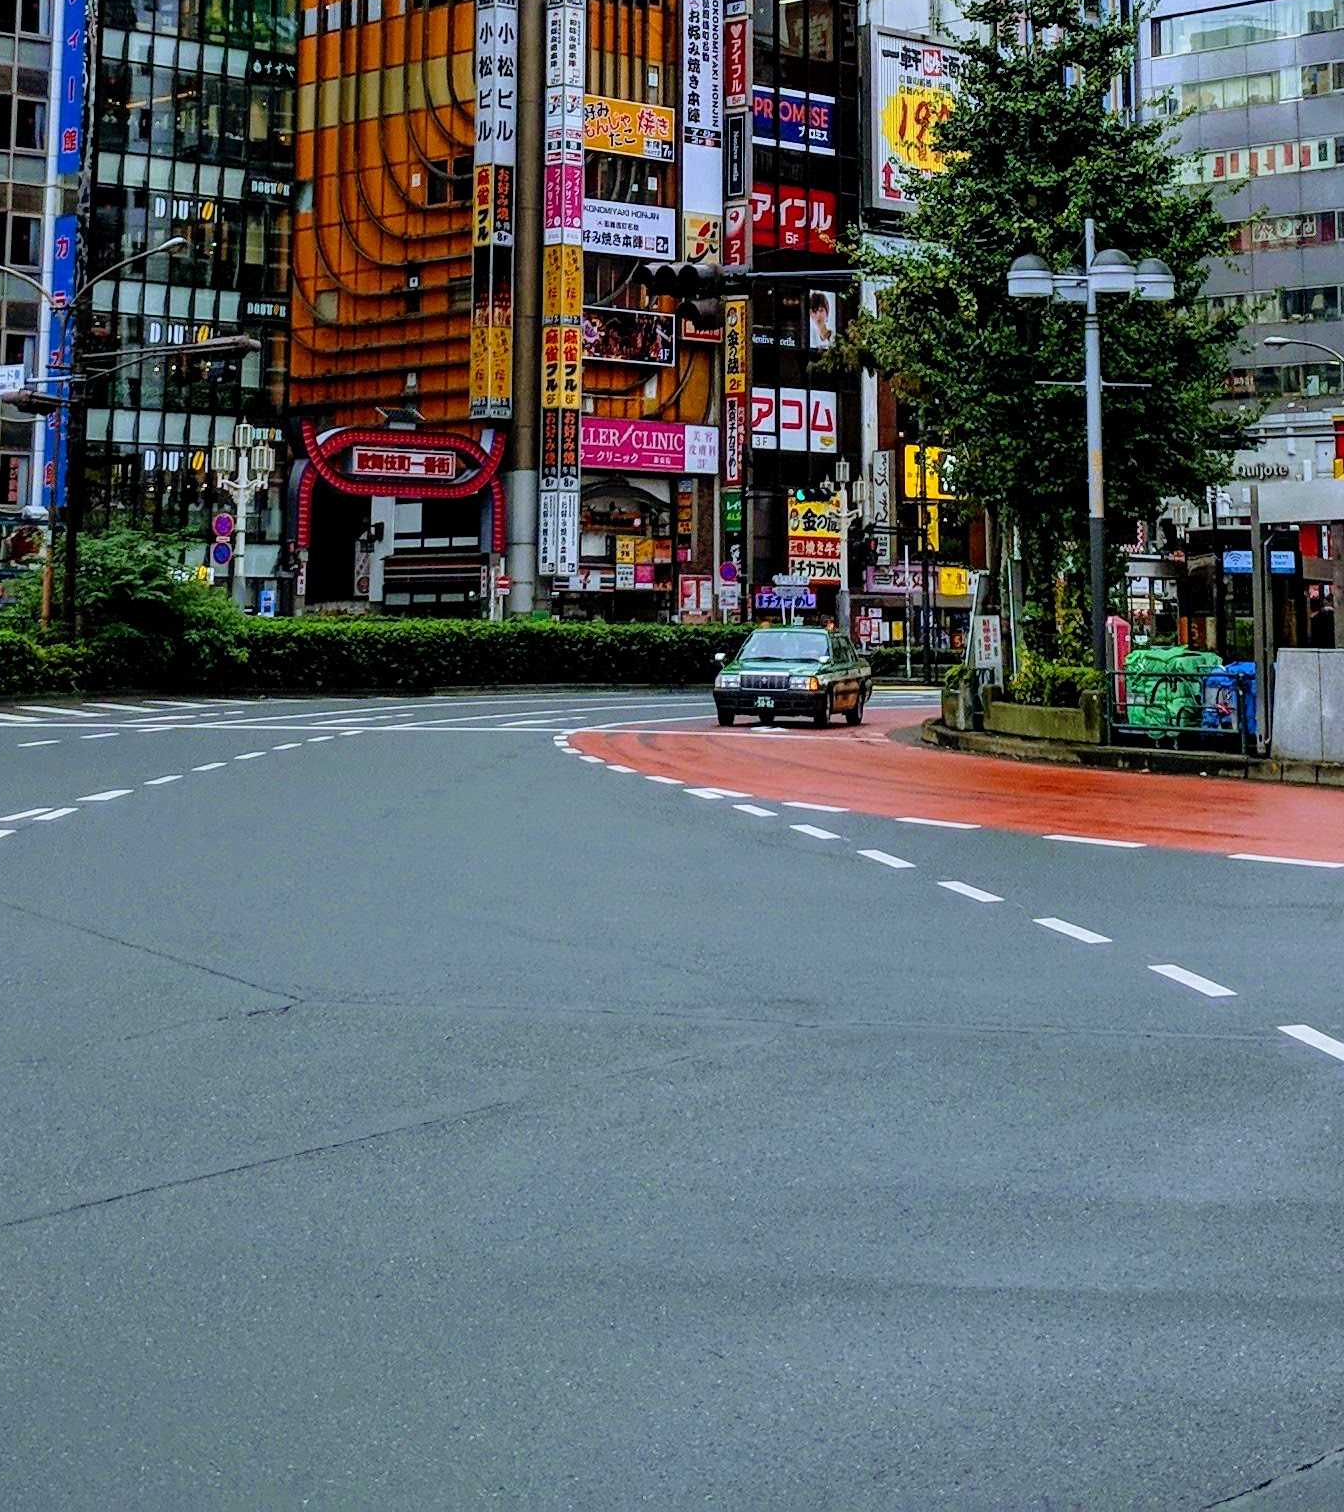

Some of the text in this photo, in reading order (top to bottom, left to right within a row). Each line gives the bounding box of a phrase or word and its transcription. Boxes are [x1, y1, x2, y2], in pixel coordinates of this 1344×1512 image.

[731, 39, 742, 93] アイフル
[478, 22, 493, 143] 小松ビル
[497, 22, 515, 142] 小松ビル
[637, 109, 669, 136] 焼き
[752, 192, 832, 231] アイフル
[786, 232, 799, 244] 5F
[729, 378, 741, 391] 2F
[751, 397, 834, 432] アコム
[632, 430, 684, 451] CLINIC
[756, 437, 768, 447] 3F
[598, 451, 638, 465] クリニック
[1236, 462, 1289, 479] Quijote
